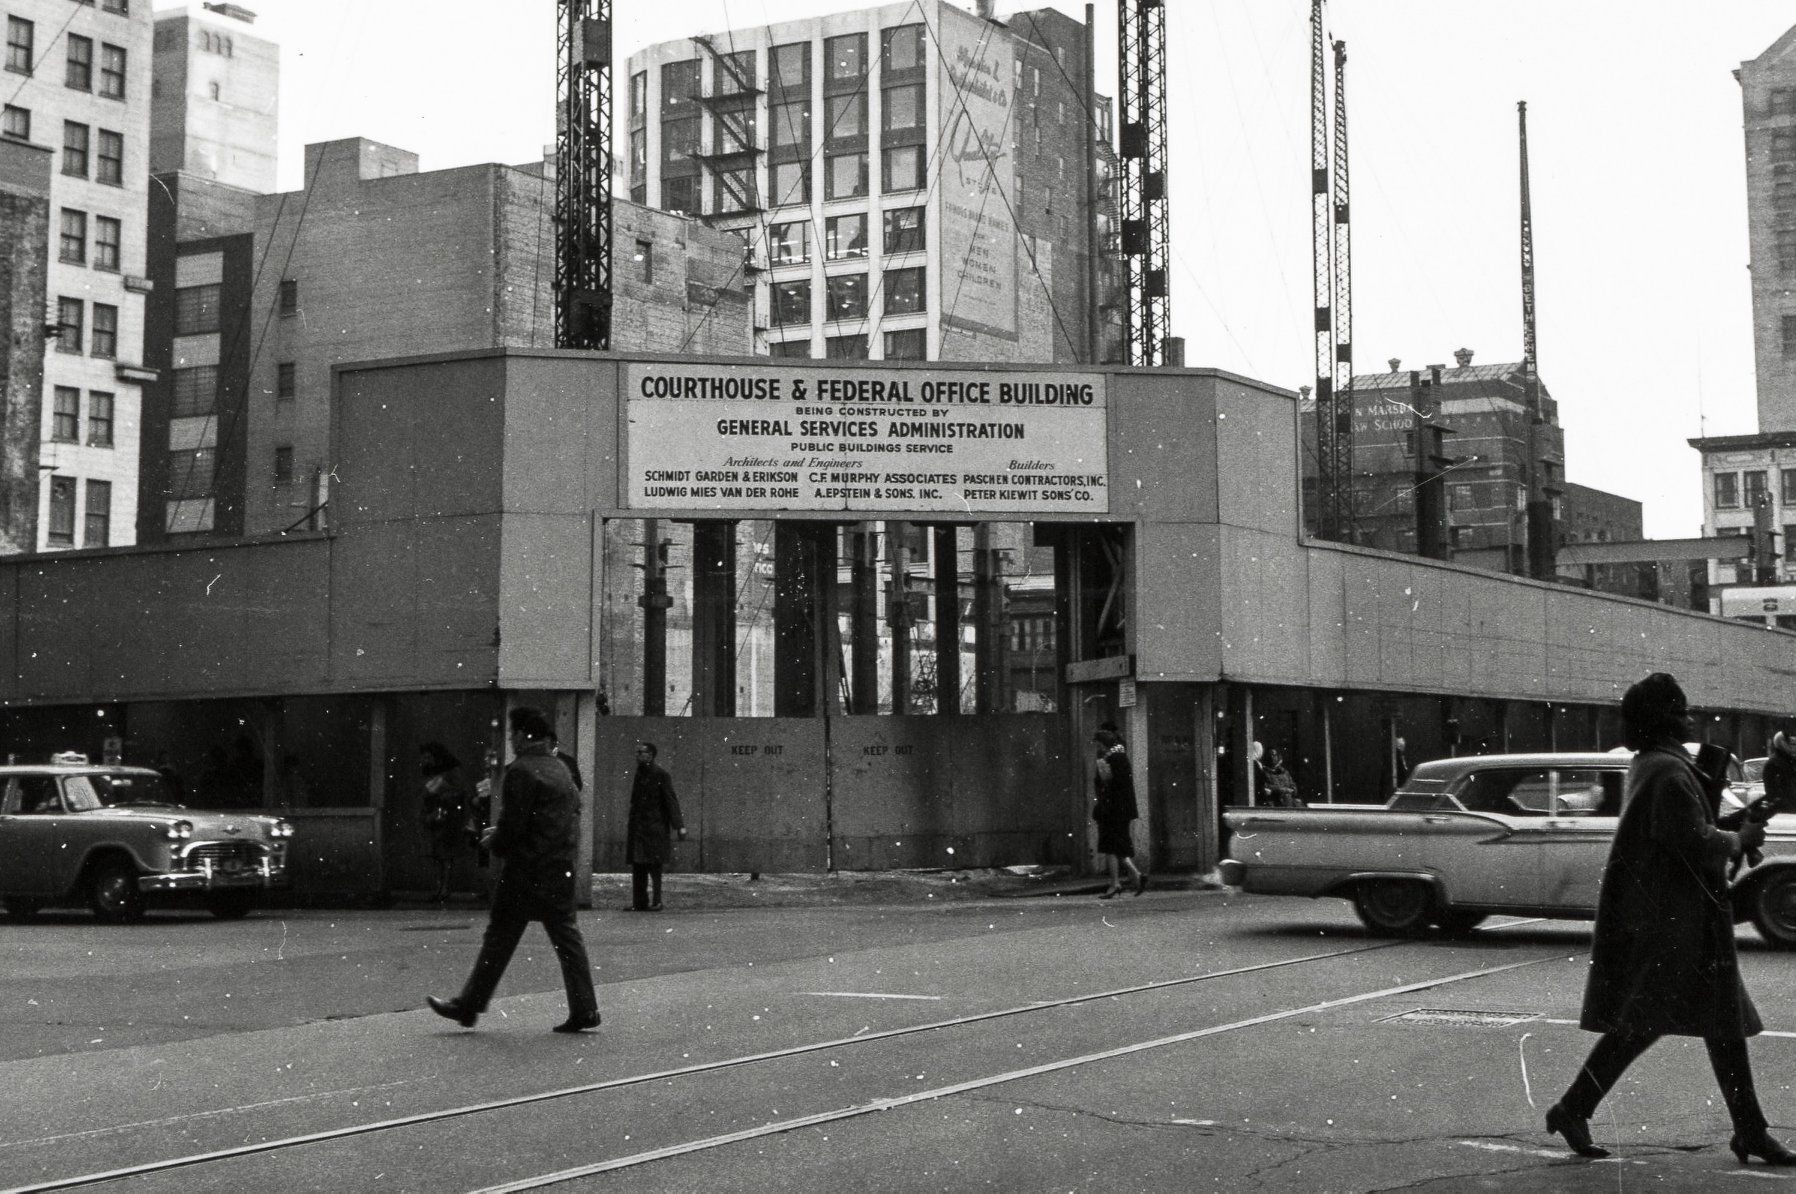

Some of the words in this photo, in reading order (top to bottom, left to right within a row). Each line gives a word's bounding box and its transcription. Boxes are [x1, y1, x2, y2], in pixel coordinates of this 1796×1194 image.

[640, 376, 780, 400] COURTHOUSE
[792, 379, 807, 400] &
[818, 379, 913, 402] FEDERAL
[921, 382, 990, 403] OFFICE
[999, 383, 1093, 406] BUILDING
[796, 407, 832, 415] BEING
[839, 407, 926, 416] CONSTRUCTED
[933, 409, 948, 417] BY
[717, 420, 792, 435] GENERAL
[801, 421, 878, 437] SERVICES
[888, 422, 1024, 438] ADMINISTRATION
[791, 443, 834, 451] PUBLIC
[839, 443, 901, 452] BUILDINGS
[906, 444, 953, 453] SERVICE
[722, 456, 779, 467] Architects
[783, 458, 805, 468] and
[807, 458, 863, 470] Engineers
[1009, 460, 1054, 470] Builders
[645, 471, 690, 481] SCHMIDT
[696, 471, 738, 482] GARDEN
[743, 471, 750, 482] &
[753, 472, 797, 482] ERIKSON
[831, 473, 879, 483] MURPHY
[885, 474, 957, 484] ASSOCIATES
[964, 475, 1008, 484] PASCHEN
[645, 487, 687, 497] LUDWIG
[691, 487, 716, 497] MIES
[721, 487, 742, 497] VAN
[746, 488, 766, 497] DER
[771, 488, 798, 497] ROHE
[874, 488, 882, 498] &
[920, 489, 942, 499] INC.
[964, 489, 996, 499] PETER
[1000, 490, 1037, 500] KIEWIT
[1075, 491, 1093, 501] CO.
[731, 745, 757, 755] KEEP
[764, 745, 783, 755] OUT
[863, 746, 888, 756] KEEP
[895, 745, 913, 755] OUT
